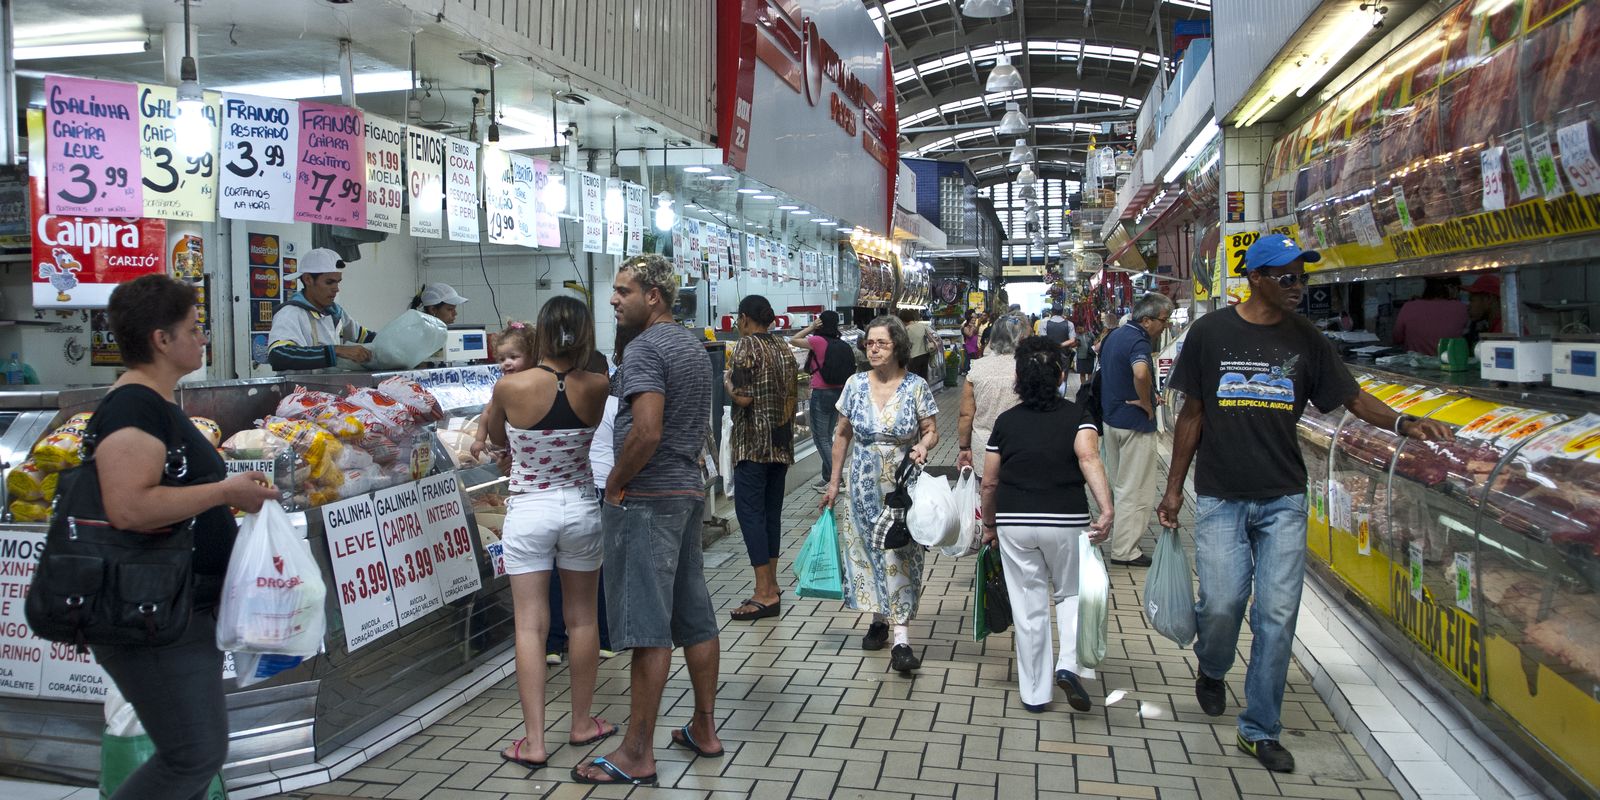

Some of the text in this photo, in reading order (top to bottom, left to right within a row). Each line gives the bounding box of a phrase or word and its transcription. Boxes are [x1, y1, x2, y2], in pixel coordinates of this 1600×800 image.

[227, 99, 289, 126] FRANGO
[302, 109, 361, 137] FRANGO
[230, 123, 288, 141] RESFRIADO
[364, 122, 400, 146] FÍGADO
[735, 126, 746, 149] 22
[410, 131, 441, 166] TEMOS
[452, 142, 470, 157] TEMOS
[378, 151, 399, 172] 1,99
[450, 155, 475, 172] COXA
[368, 168, 400, 186] MOELA
[452, 172, 470, 187] ASA
[224, 186, 270, 199] CORTAMOS
[379, 187, 400, 209] 3,99
[234, 201, 270, 210] NA HORA
[459, 206, 476, 220] PERU
[37, 214, 140, 254] Caipira
[1232, 232, 1261, 248] BOX
[1237, 399, 1270, 408] ESPECIAL
[1270, 402, 1294, 411] AVATAR
[225, 462, 272, 472] GALINHA LEVE
[422, 478, 456, 502] FRANGO
[376, 489, 418, 516] GALINHA
[426, 500, 460, 525] INTEIRO
[328, 501, 372, 529] GALINHA
[382, 512, 424, 548] CAIPIRA
[334, 530, 376, 558] LEVE
[433, 526, 471, 564] R$ 3,99
[392, 547, 434, 588] R$ 3,99
[342, 560, 388, 605] R$ 3,99
[444, 578, 480, 598] CORAÇÃO VALENTE
[2, 602, 10, 616] E
[400, 597, 440, 620] CORAÇÃO VALENTE
[350, 619, 395, 648] CORAÇÃO VALENTE
[0, 644, 41, 663] RINHO
[48, 683, 108, 696] CORAÇÃO VALE
